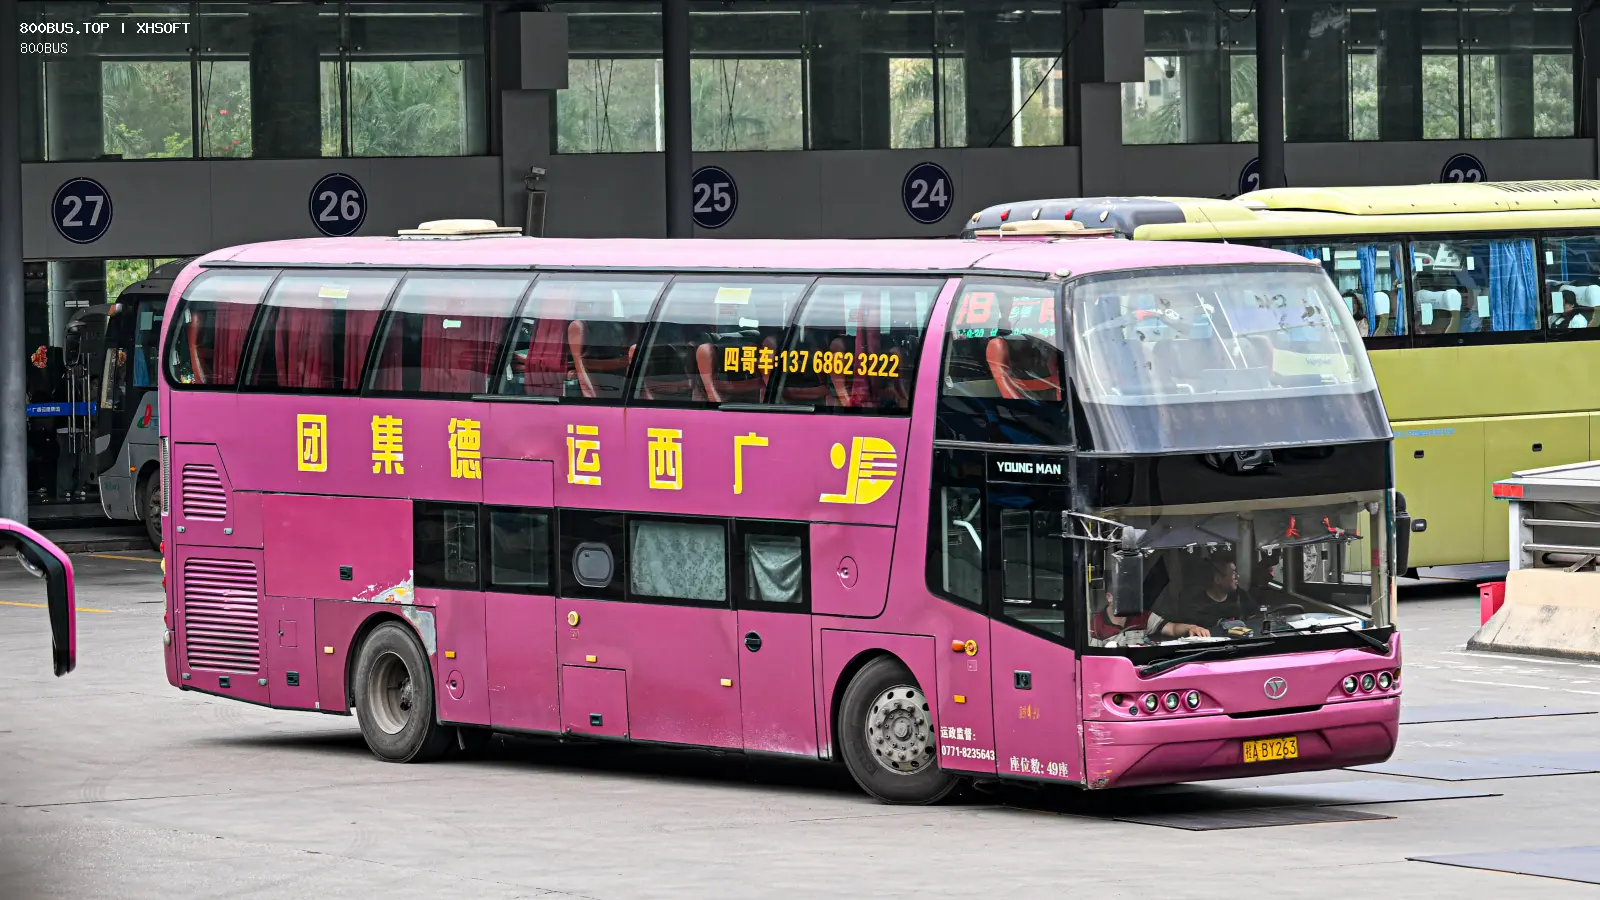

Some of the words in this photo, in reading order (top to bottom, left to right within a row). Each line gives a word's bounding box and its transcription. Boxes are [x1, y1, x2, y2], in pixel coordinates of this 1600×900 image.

[319, 190, 361, 221] 26
[693, 182, 731, 213] 25
[911, 178, 948, 209] 24
[62, 195, 104, 227] 27
[812, 350, 854, 375] 6862
[857, 353, 899, 378] 3222
[996, 461, 1034, 474] YOUNG
[1035, 463, 1062, 475] MAN
[941, 745, 996, 761] 0771-8235643
